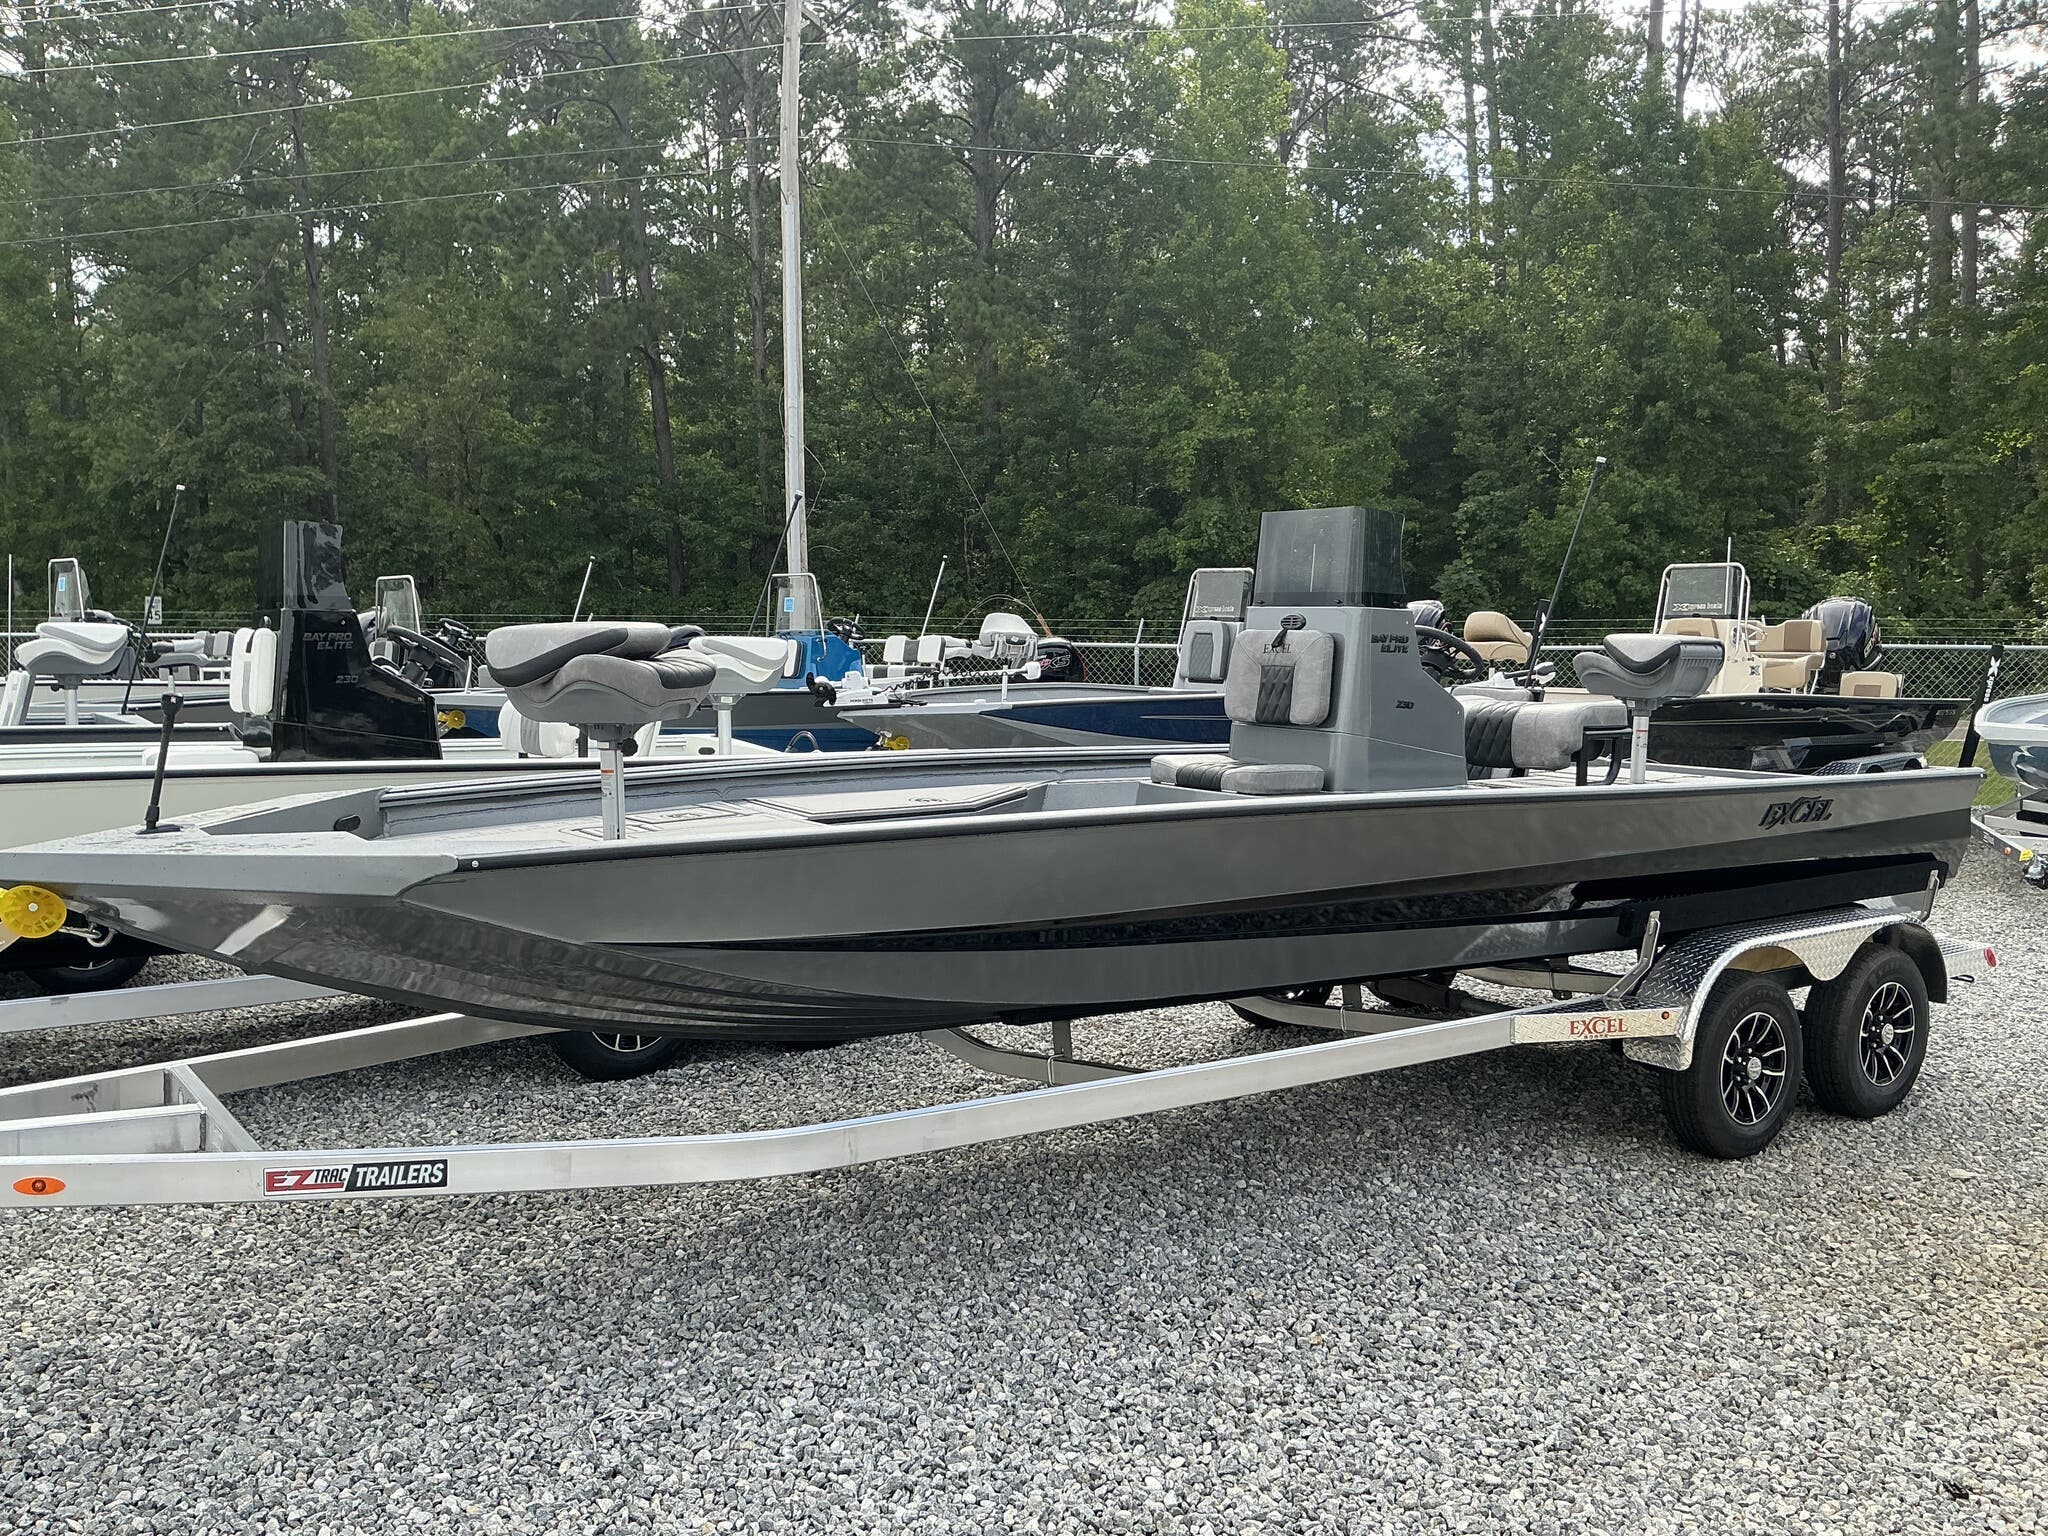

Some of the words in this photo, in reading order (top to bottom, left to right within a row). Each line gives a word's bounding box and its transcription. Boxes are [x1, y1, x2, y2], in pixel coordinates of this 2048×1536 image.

[303, 632, 327, 641] BAY
[327, 632, 353, 641] PRO
[1371, 634, 1388, 644] BAY
[1389, 634, 1409, 644] PRO
[317, 641, 354, 650] ELITE
[1380, 644, 1409, 653] ELITE
[336, 675, 359, 684] 230
[1396, 700, 1415, 710] 230
[1758, 796, 1834, 830] EXCEL
[1570, 1016, 1629, 1037] EXCEL
[266, 1169, 344, 1192] EZ
[315, 1168, 348, 1184] TRAC
[356, 1163, 444, 1188] TRAILERS
